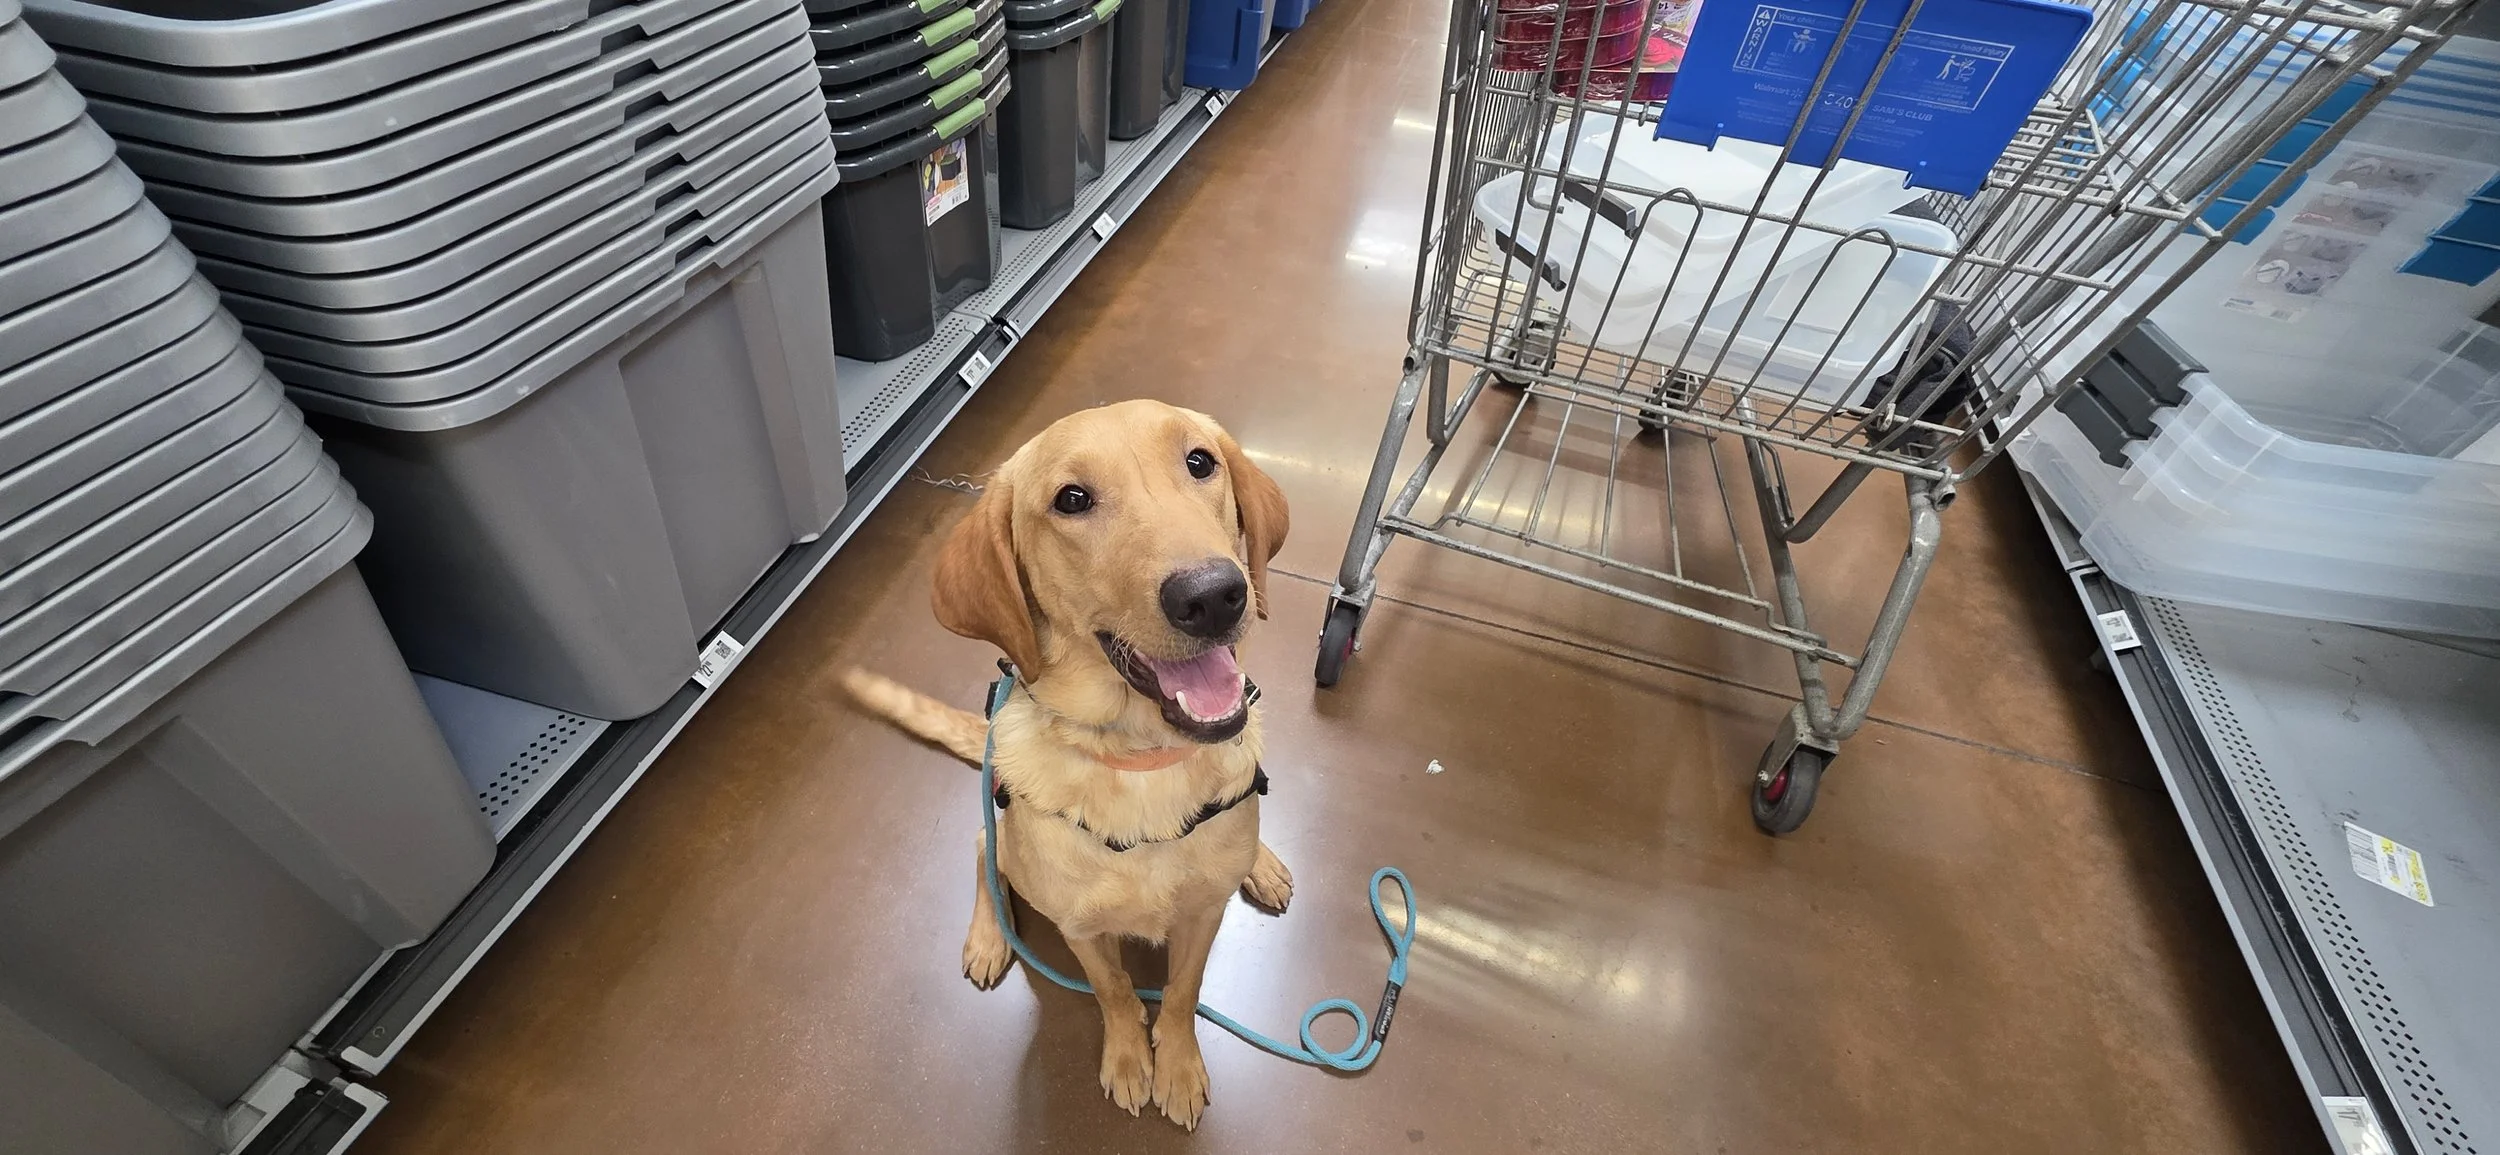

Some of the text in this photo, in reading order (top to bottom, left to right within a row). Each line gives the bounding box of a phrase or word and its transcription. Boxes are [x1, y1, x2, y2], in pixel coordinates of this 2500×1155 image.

[1778, 12, 1796, 22] Your
[1740, 19, 1769, 67] WARNING
[1960, 43, 1982, 53] head
[1982, 46, 2007, 58] injury
[1753, 82, 1790, 96] Walmart
[1872, 104, 1904, 117] SAM'S
[1905, 110, 1934, 122] CLUB
